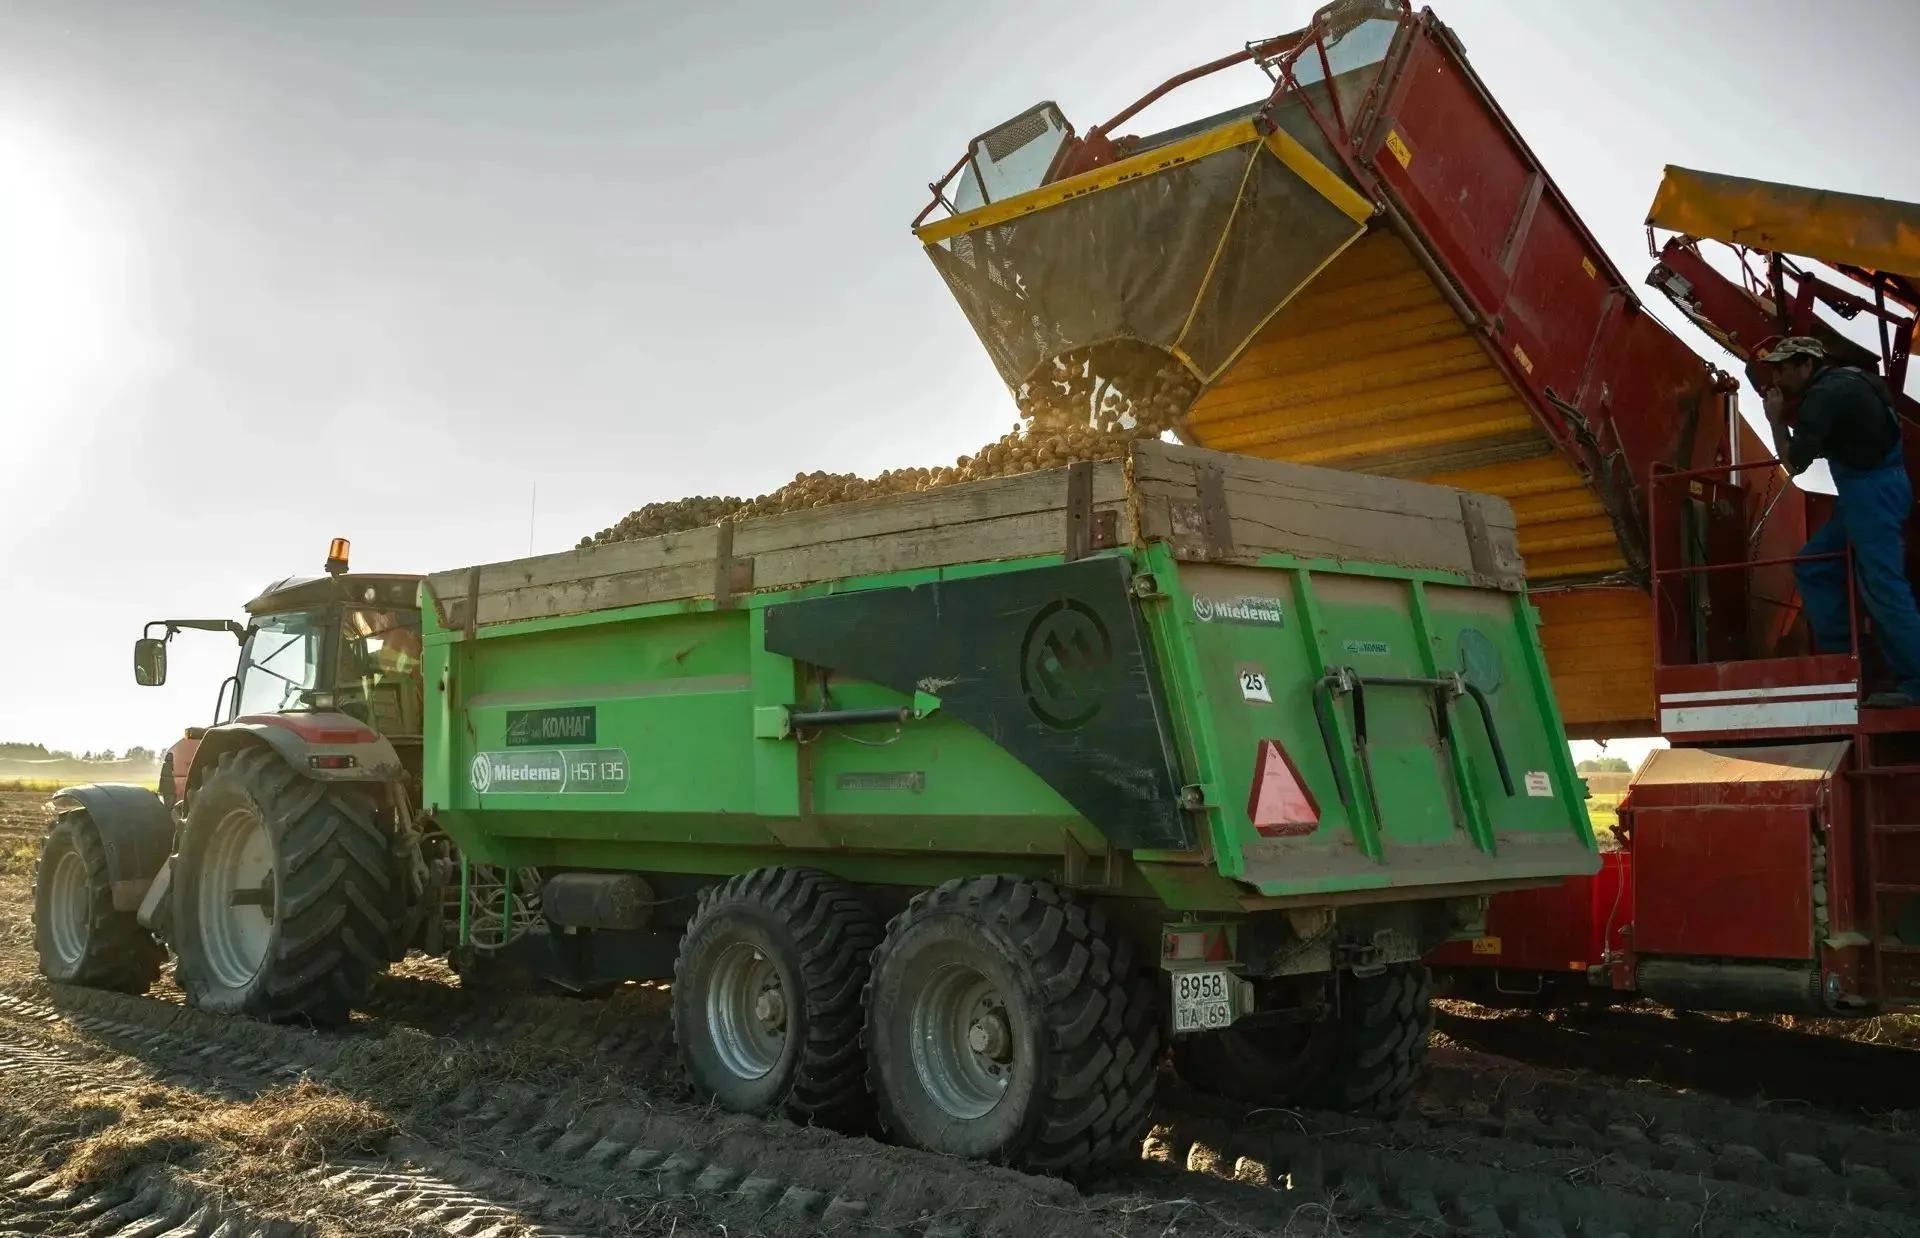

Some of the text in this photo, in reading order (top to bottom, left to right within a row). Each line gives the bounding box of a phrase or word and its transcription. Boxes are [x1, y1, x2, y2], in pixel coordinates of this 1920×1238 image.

[1214, 602, 1281, 622] Miedema
[1243, 673, 1263, 691] 25
[542, 715, 591, 738] КОЛНАГ
[494, 761, 624, 781] Miedema HST 135
[1180, 974, 1222, 1000] 8958
[1208, 1005, 1226, 1024] 69
